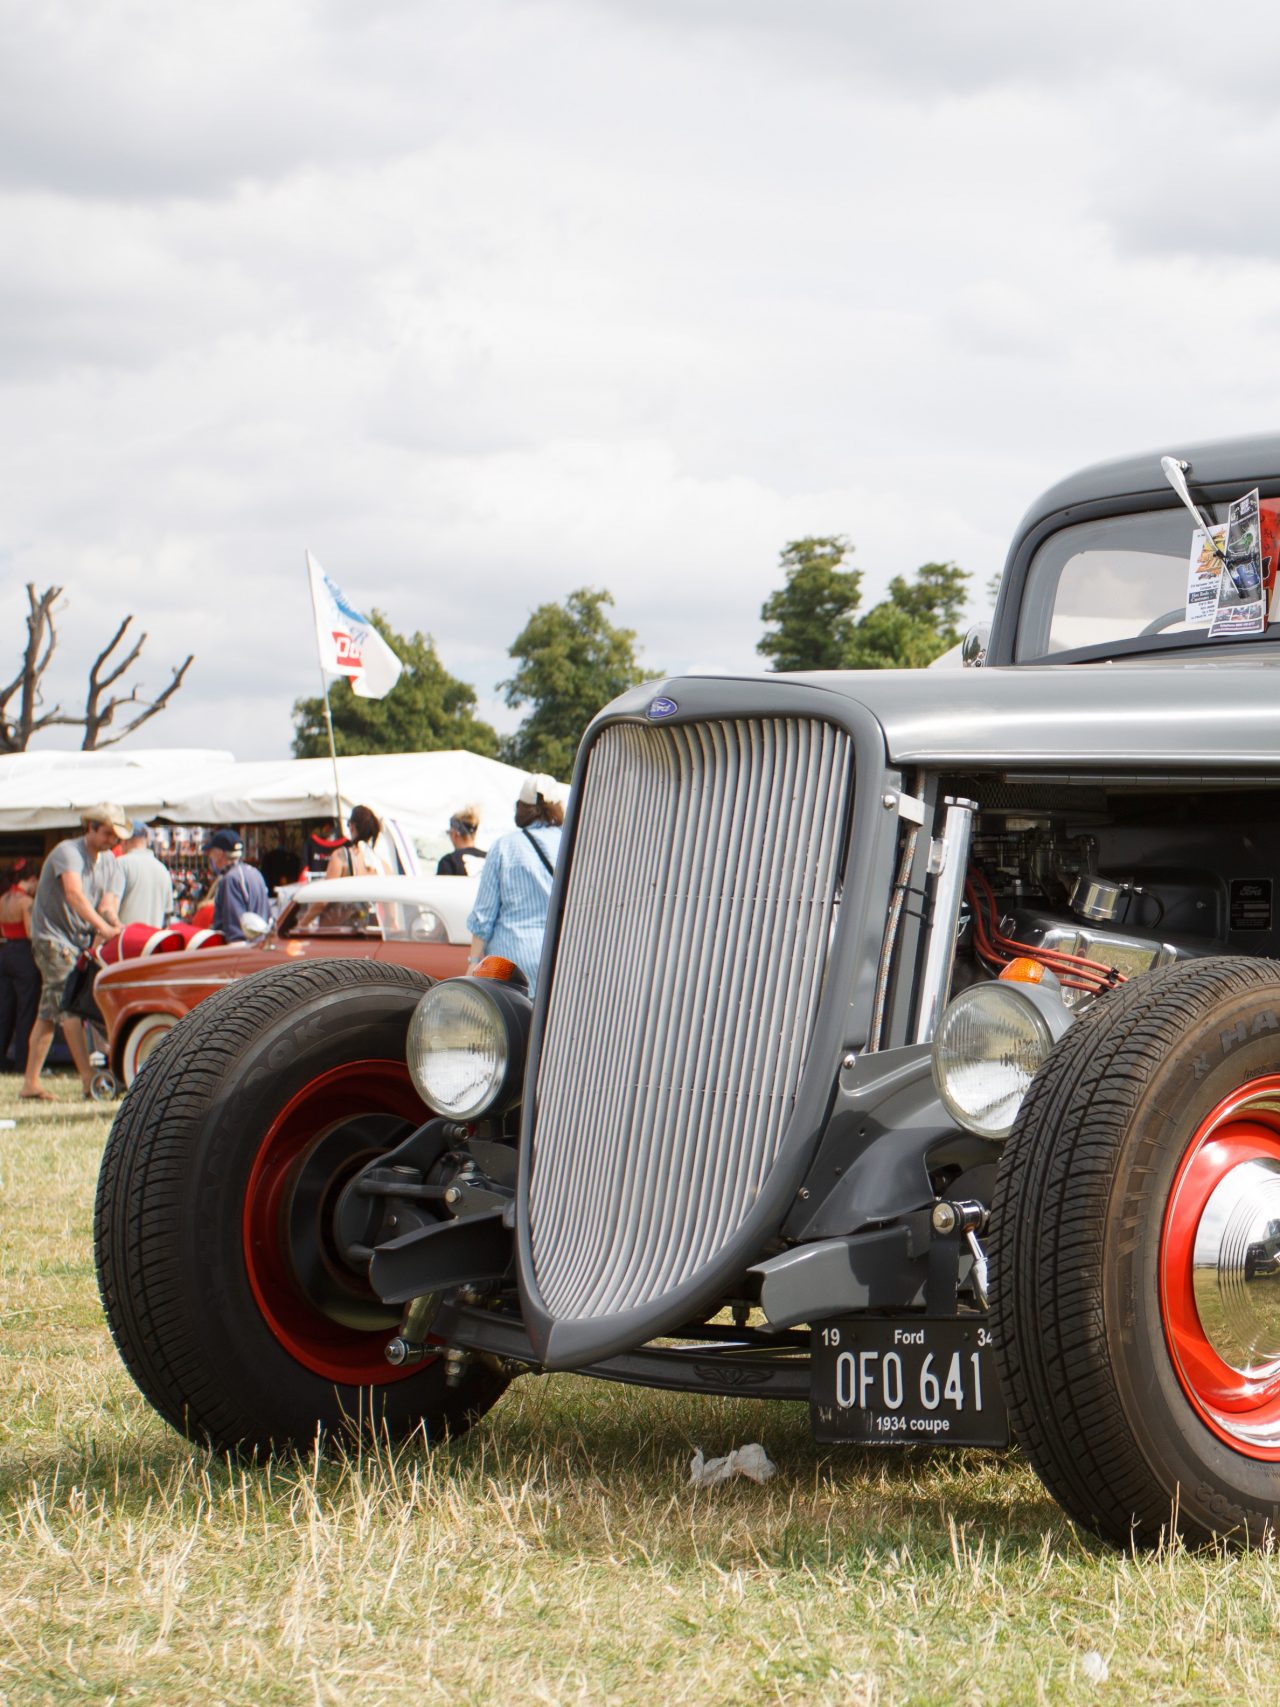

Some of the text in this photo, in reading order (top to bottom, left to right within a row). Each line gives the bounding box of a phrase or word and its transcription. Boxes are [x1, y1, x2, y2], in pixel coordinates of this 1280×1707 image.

[821, 1328, 840, 1346] 19
[894, 1329, 924, 1345] Ford
[919, 1352, 983, 1411] 641
[876, 1416, 950, 1433] 1934 coupe
